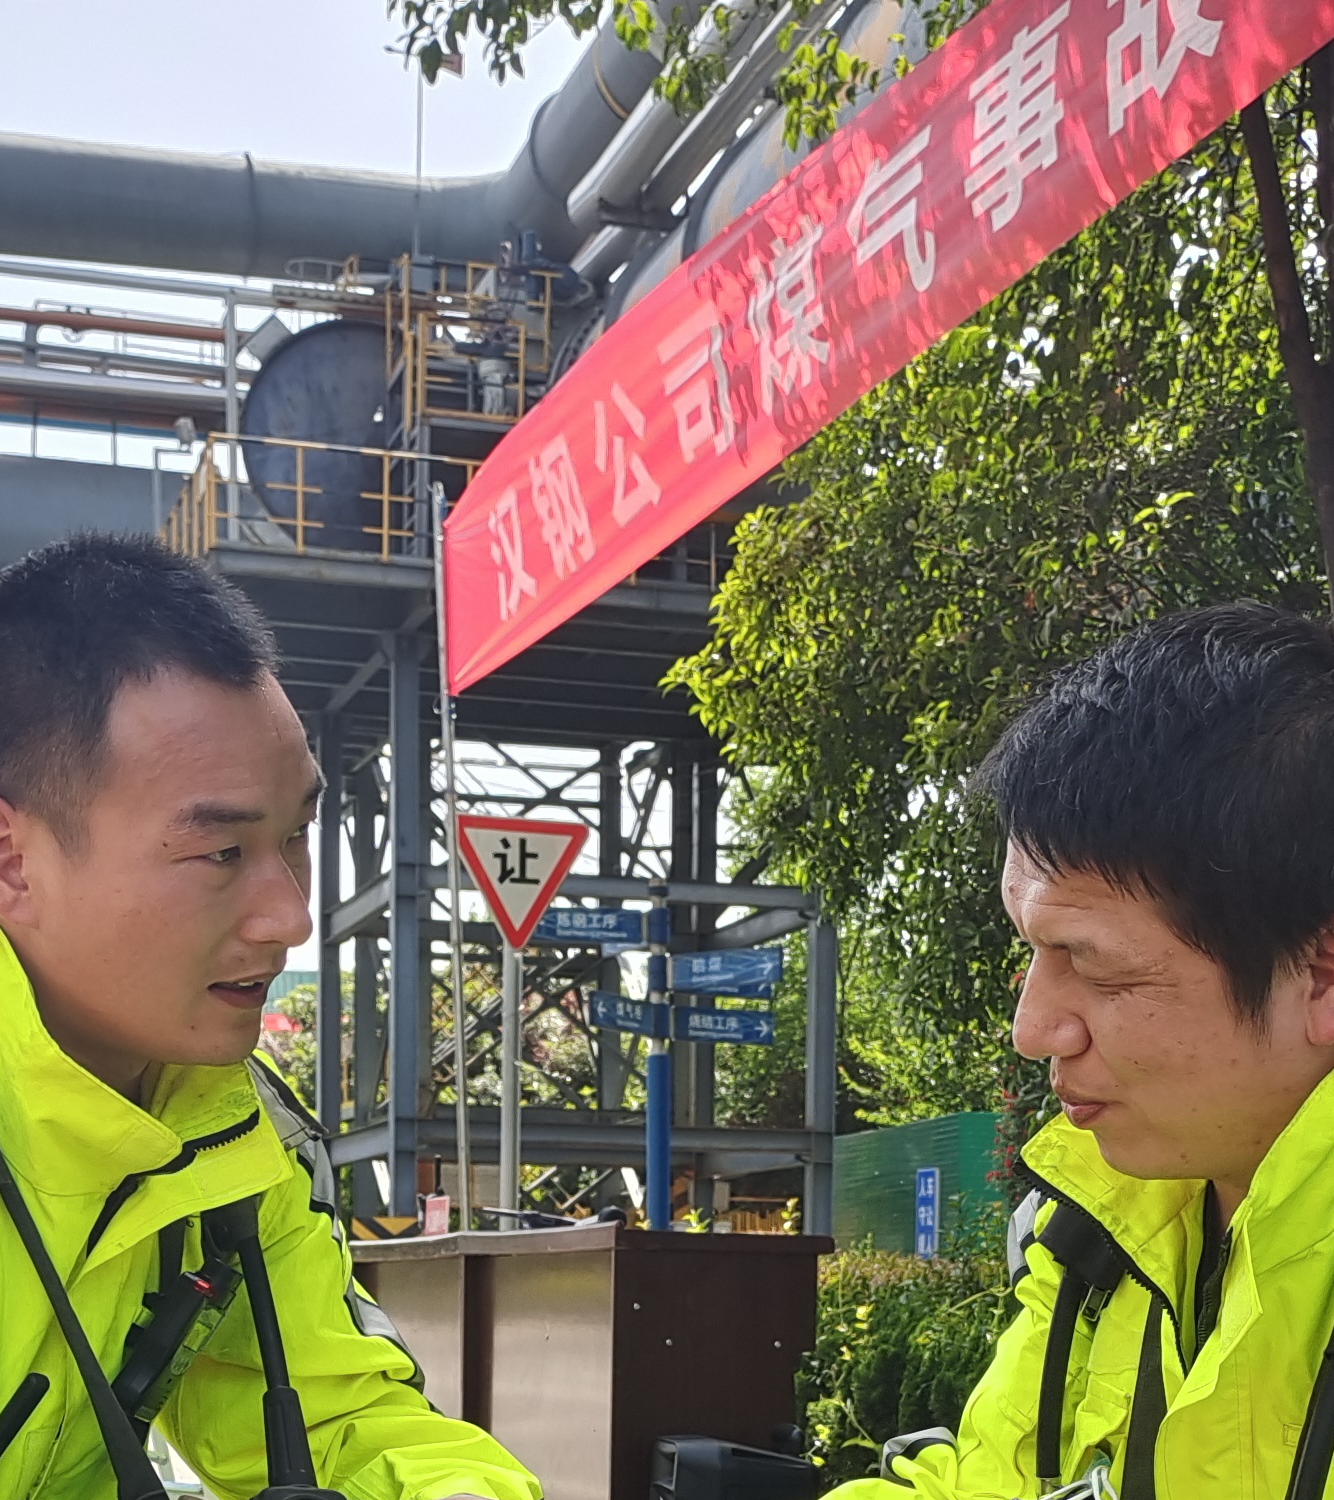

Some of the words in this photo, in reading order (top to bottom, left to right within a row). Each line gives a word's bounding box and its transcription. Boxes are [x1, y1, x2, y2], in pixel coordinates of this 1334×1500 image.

[487, 0, 1224, 622] 汉钢公司煤气事故
[493, 837, 540, 884] 让
